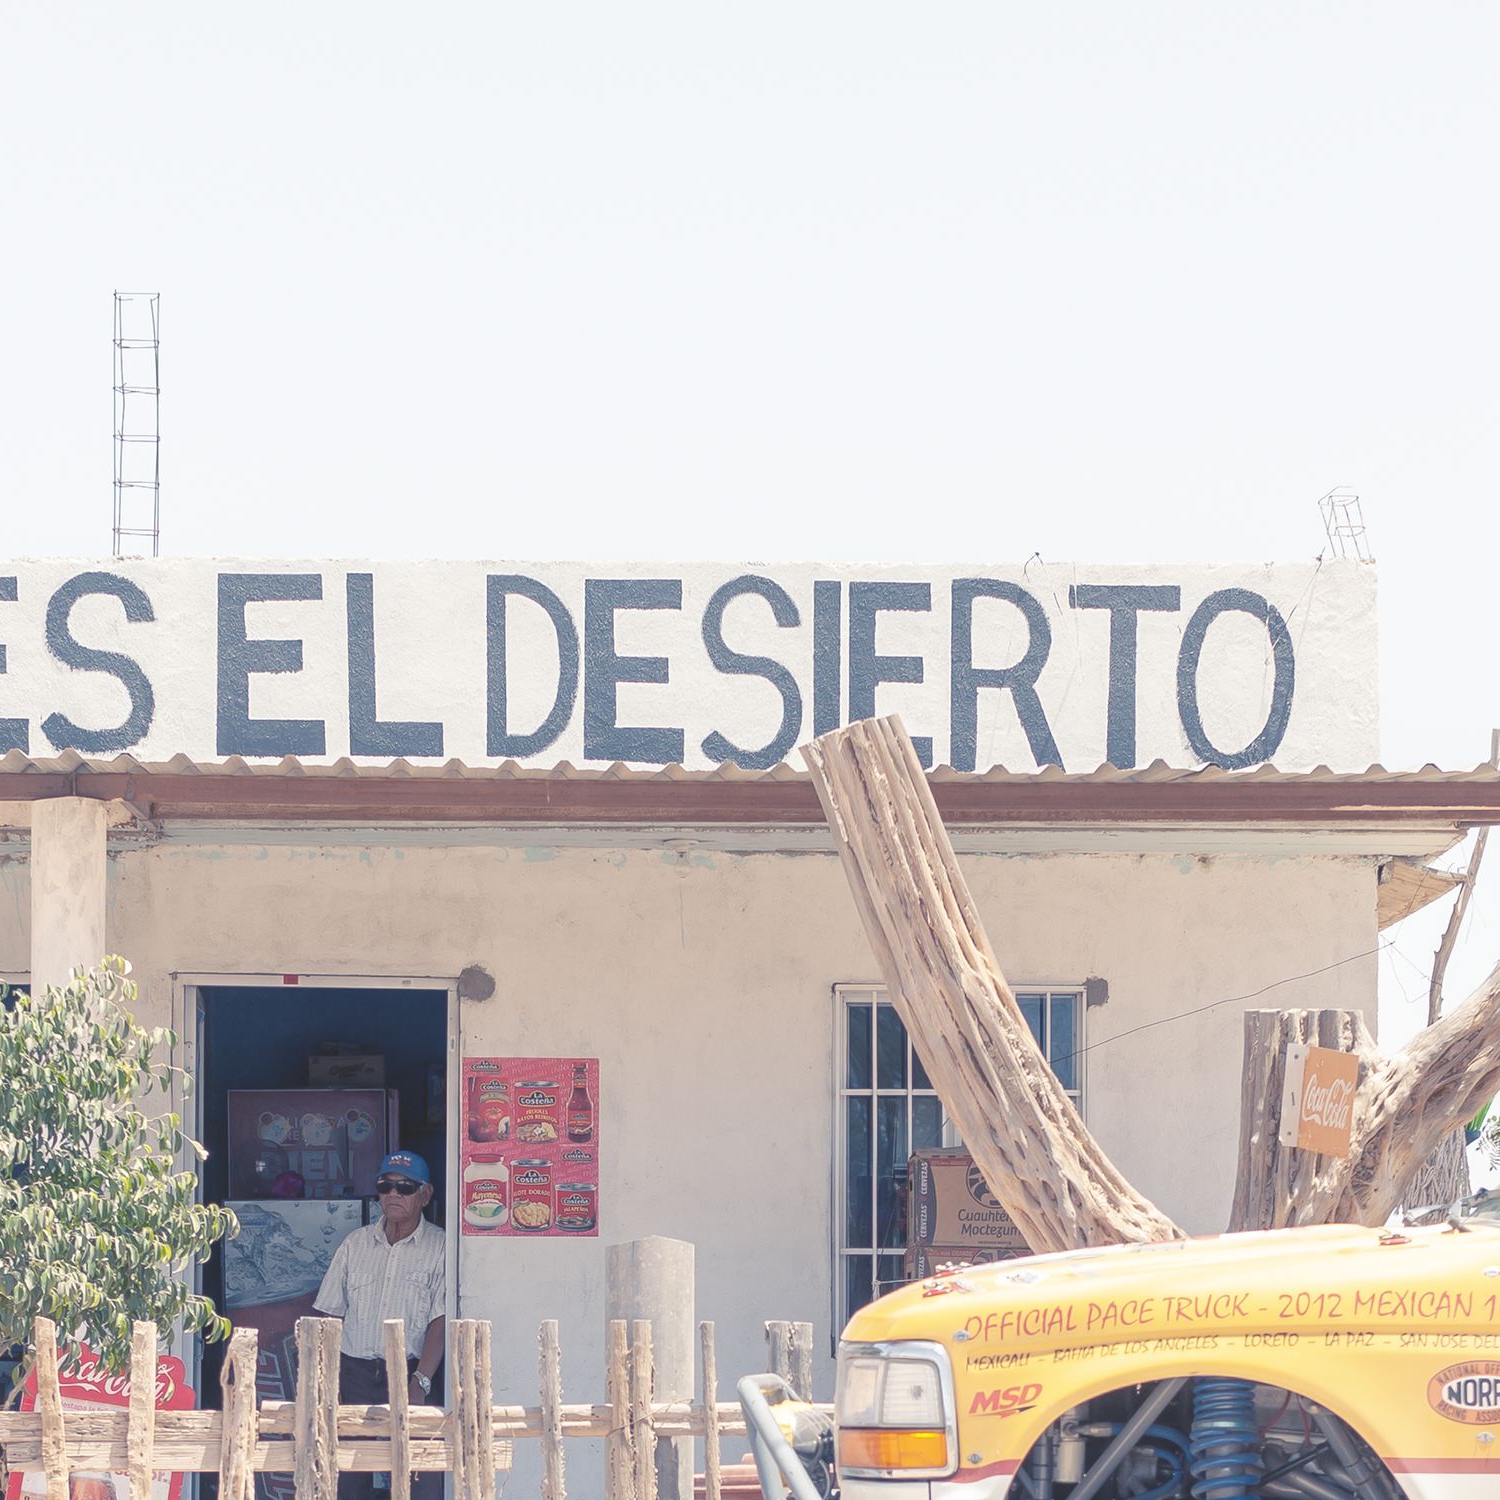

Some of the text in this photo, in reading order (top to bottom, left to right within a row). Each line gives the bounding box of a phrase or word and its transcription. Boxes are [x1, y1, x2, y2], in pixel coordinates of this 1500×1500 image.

[215, 571, 445, 757] EL
[485, 573, 1295, 773] DESIERTO
[961, 1223, 1022, 1239] Moctezum
[965, 1305, 1077, 1341] OFFICIAL
[1087, 1299, 1155, 1331] PACE
[1166, 1293, 1250, 1322] TRUCK
[1278, 1293, 1343, 1319] 2012
[1354, 1290, 1473, 1319] MEXICAN
[966, 1353, 1029, 1372] MEXICALI
[1053, 1344, 1095, 1363] BAHIA
[1100, 1341, 1118, 1357] DE
[1124, 1339, 1150, 1355] LOS
[1154, 1335, 1219, 1353] ANGELES
[1244, 1332, 1299, 1347] LORETO
[1324, 1332, 1340, 1346] LA
[1346, 1331, 1375, 1346] PAZ
[1400, 1333, 1429, 1347] SAN
[1432, 1333, 1469, 1349] JOSE
[1474, 1334, 1500, 1349] DEL
[1436, 1363, 1481, 1385] NATIONAL
[968, 1384, 1043, 1414] MSD
[1436, 1401, 1468, 1421] RACING
